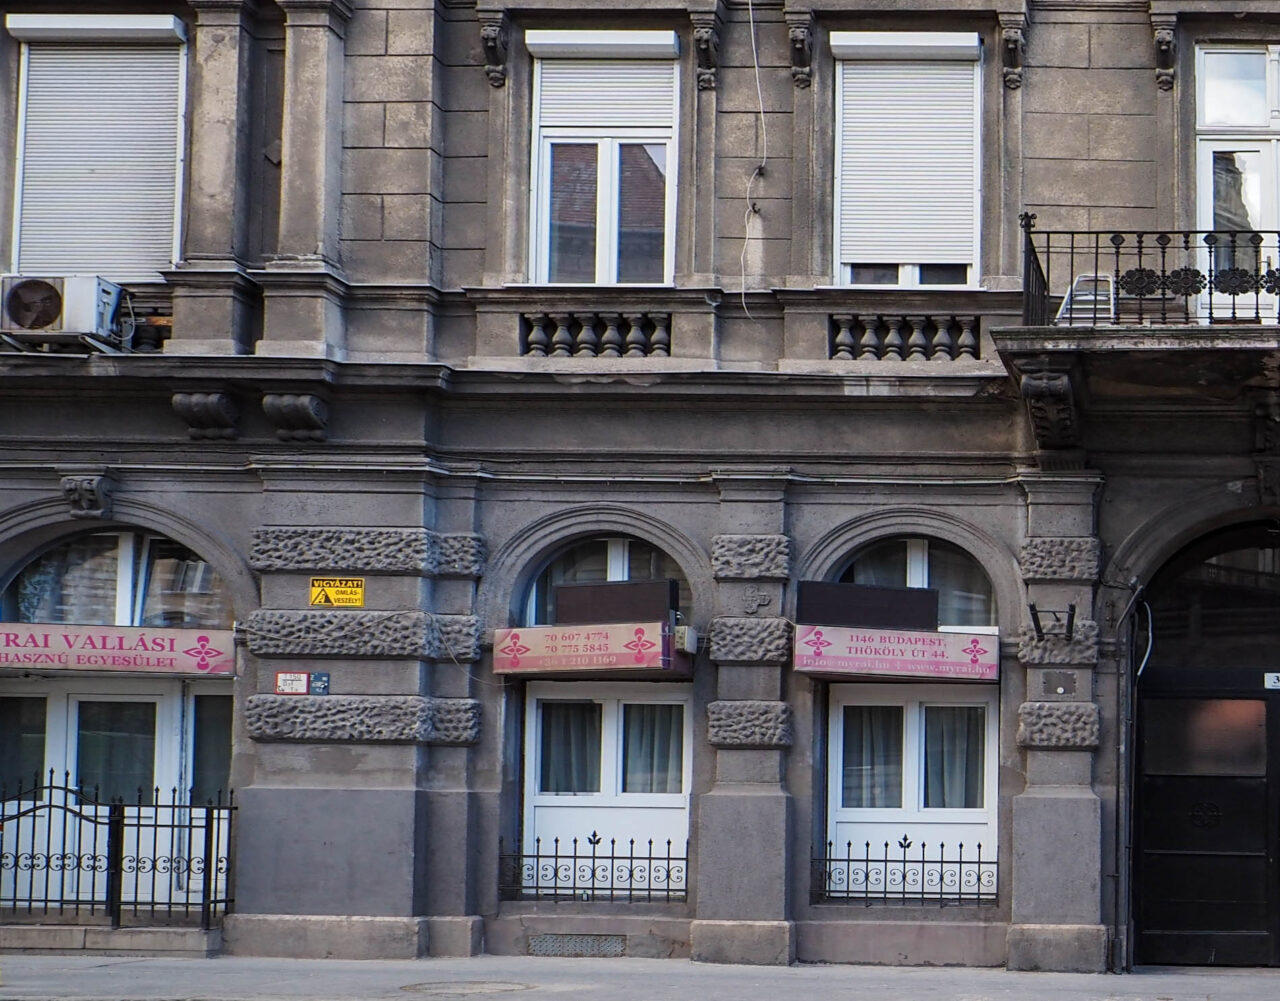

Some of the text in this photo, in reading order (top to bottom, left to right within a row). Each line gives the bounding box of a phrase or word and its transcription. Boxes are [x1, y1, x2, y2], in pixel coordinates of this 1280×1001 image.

[313, 579, 362, 588] VIGYÁZAT!
[335, 588, 360, 596] OMLÁS-
[545, 632, 609, 642] 70 607 4774
[850, 635, 947, 648] 1146 BUDAPEST,
[0, 632, 176, 653] RAI VALLÁSI
[545, 643, 609, 653] 70 775 5845
[847, 645, 949, 659] THÖKÖLY ÚT 44.
[76, 654, 177, 668] EGYESÜLET
[593, 655, 617, 665] 1169
[1273, 676, 1280, 684] 3
